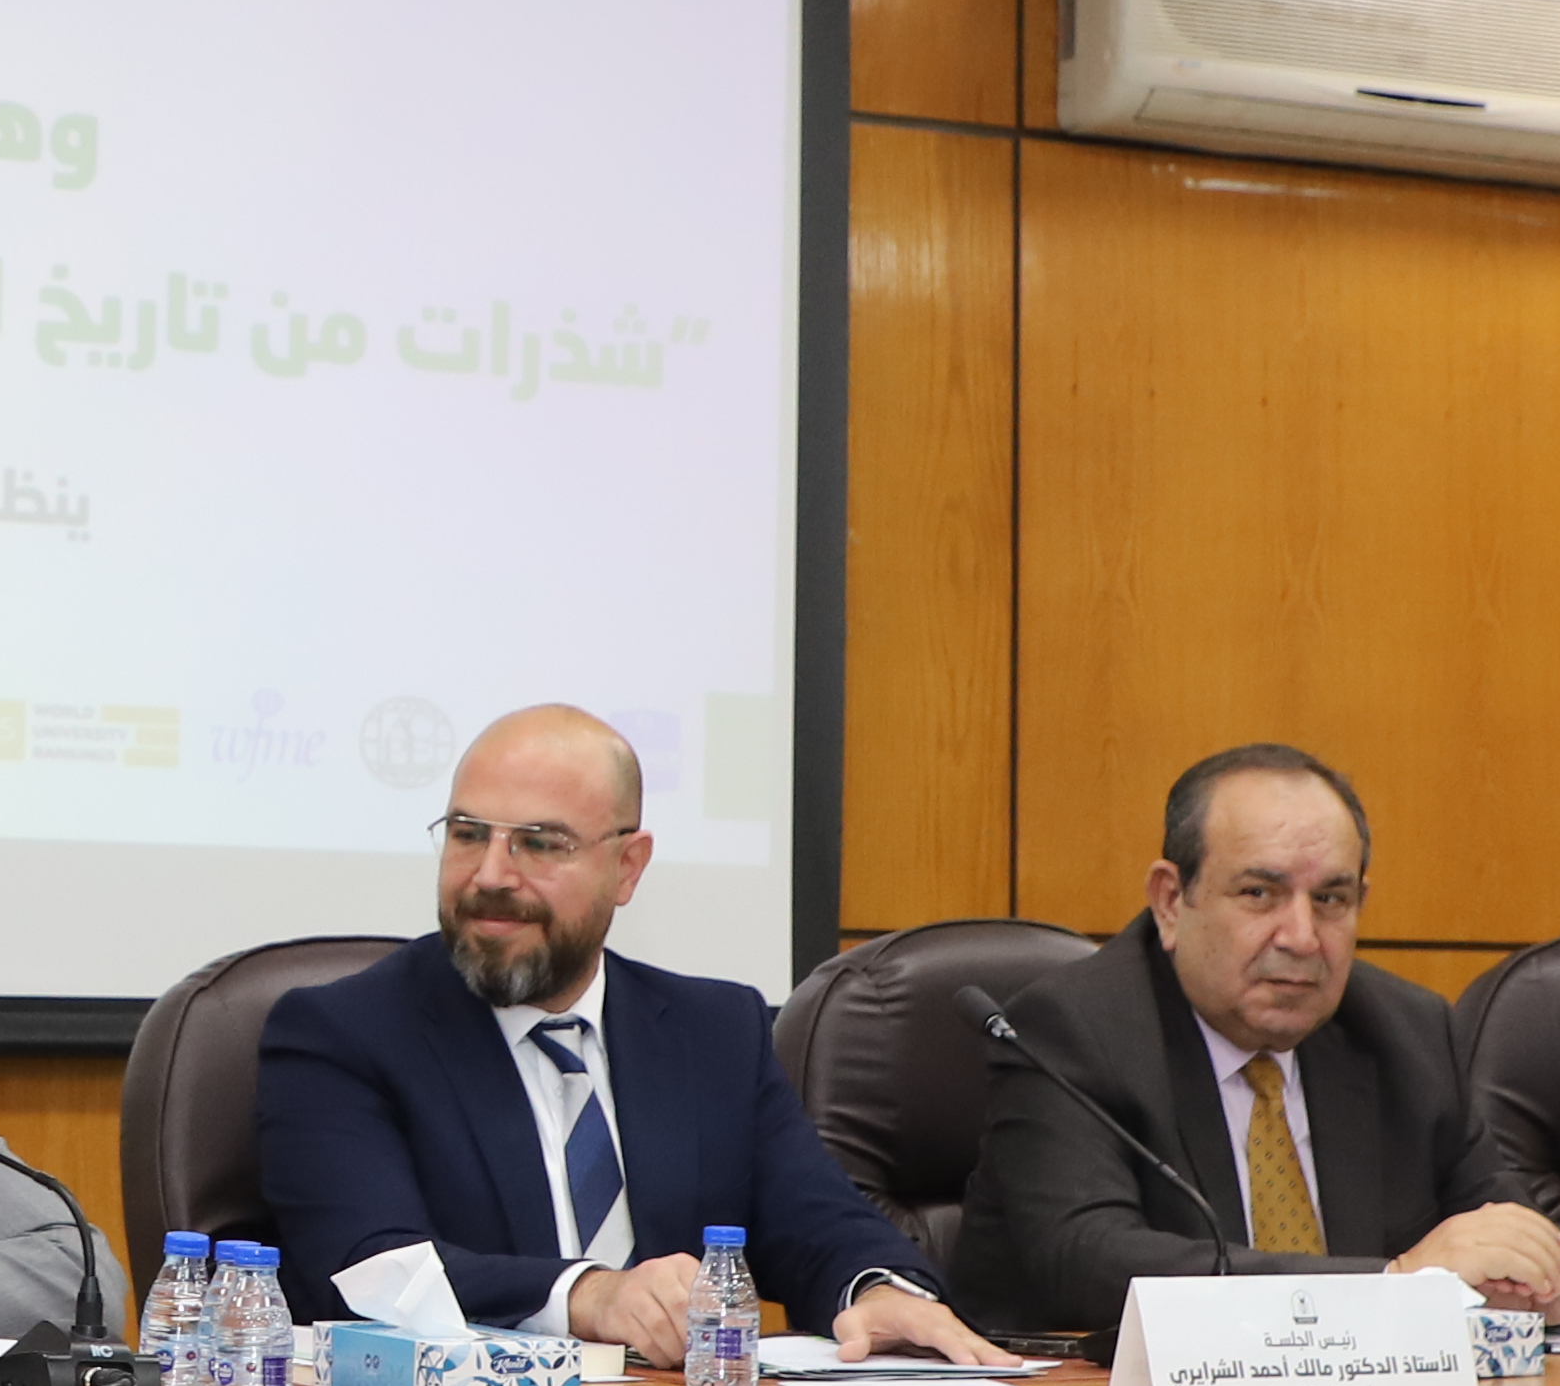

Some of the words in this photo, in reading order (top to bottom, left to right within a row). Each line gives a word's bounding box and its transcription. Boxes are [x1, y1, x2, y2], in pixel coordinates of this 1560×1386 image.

[34, 263, 229, 372] تاريخ
[249, 290, 367, 379] من
[1249, 1355, 1291, 1379] أحمد
[1293, 1358, 1334, 1379] مالك
[1338, 1355, 1399, 1383] الدكتور
[1402, 1350, 1460, 1376] الأستاذ
